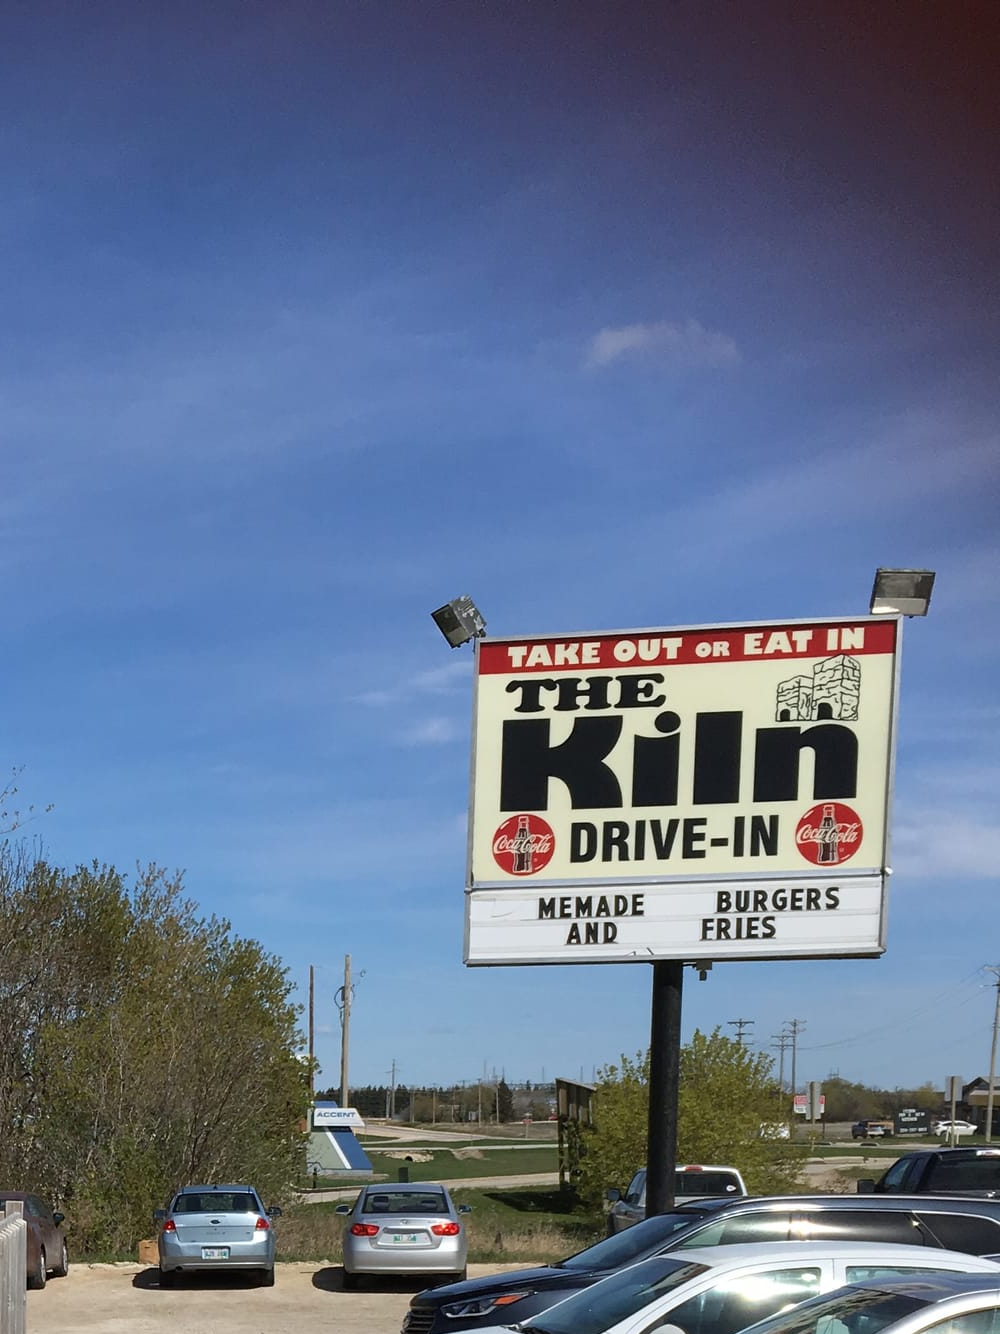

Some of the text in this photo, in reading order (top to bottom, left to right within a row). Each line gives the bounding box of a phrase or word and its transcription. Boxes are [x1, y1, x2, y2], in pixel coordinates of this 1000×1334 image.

[508, 627, 865, 668] TAKE OUT OR EAT IN
[505, 673, 667, 713] THE
[500, 710, 859, 812] Kiln
[570, 814, 779, 863] DRIVE-IN
[538, 887, 840, 919] MEMADE BURGERS
[566, 916, 777, 944] AND FRIES
